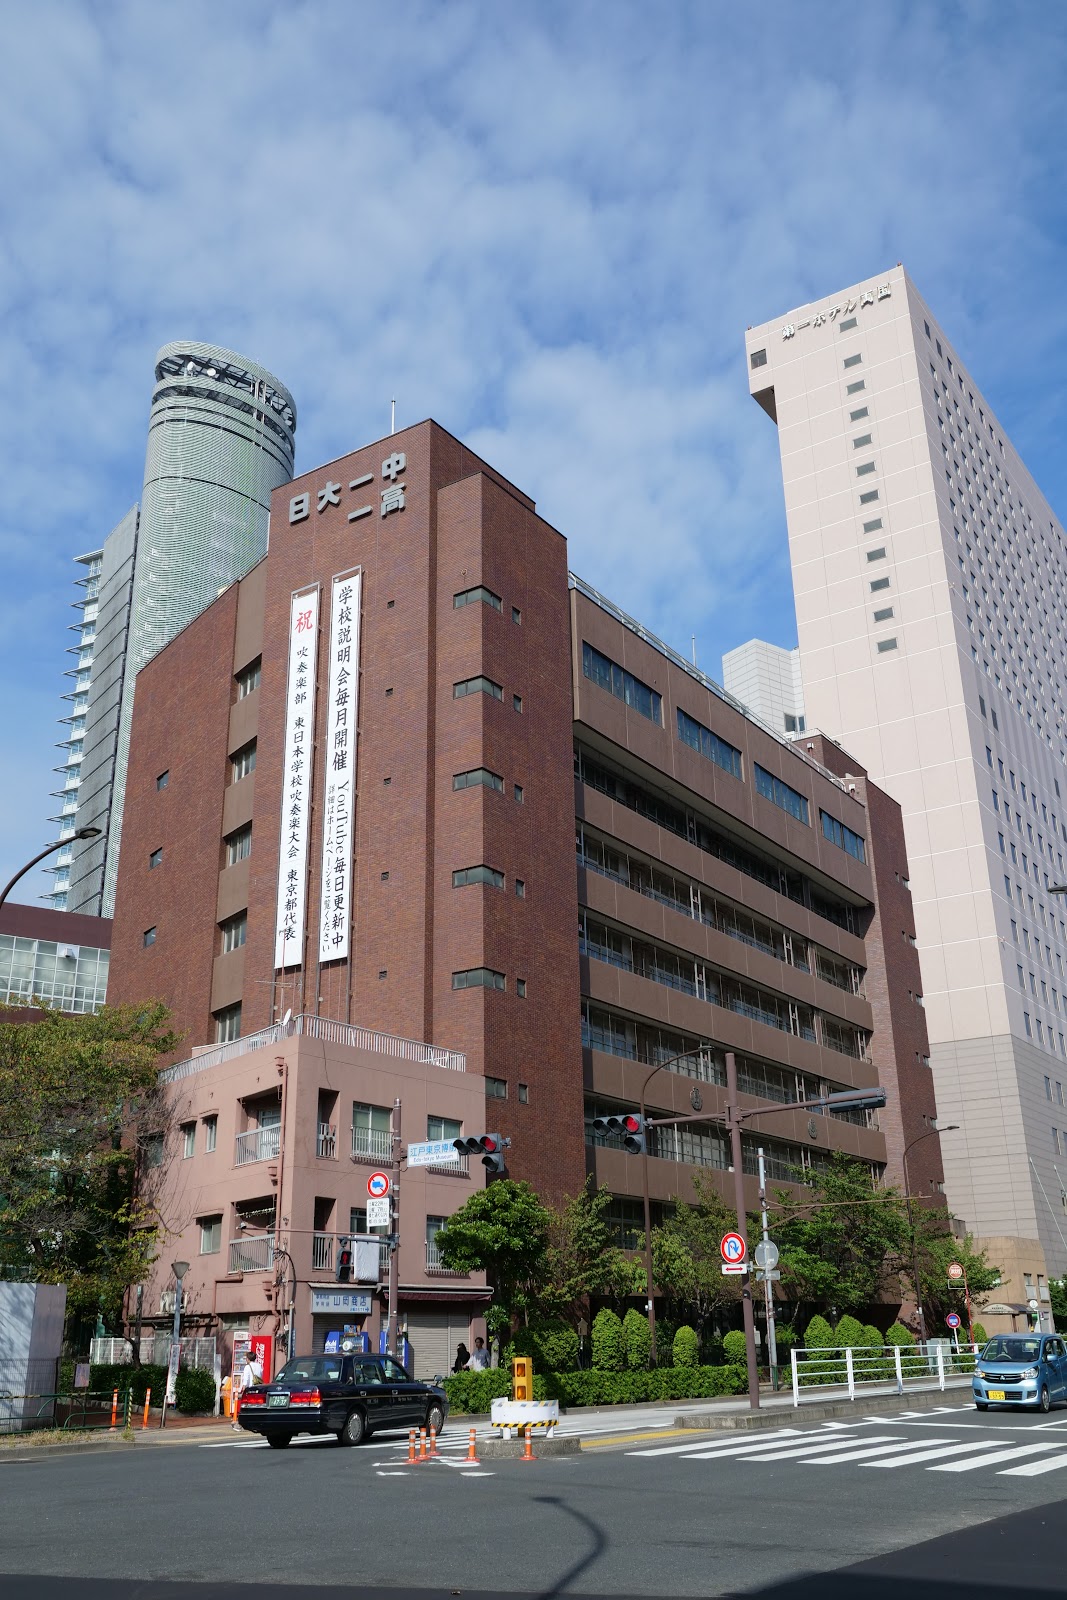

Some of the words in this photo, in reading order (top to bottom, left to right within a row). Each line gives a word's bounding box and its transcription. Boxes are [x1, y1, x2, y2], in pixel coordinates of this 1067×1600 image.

[294, 609, 313, 633] 祝
[333, 586, 353, 771] 学校説明会毎月開催
[287, 716, 305, 859] 東日本学校吹奏楽大会
[283, 868, 299, 941] 東京都代表
